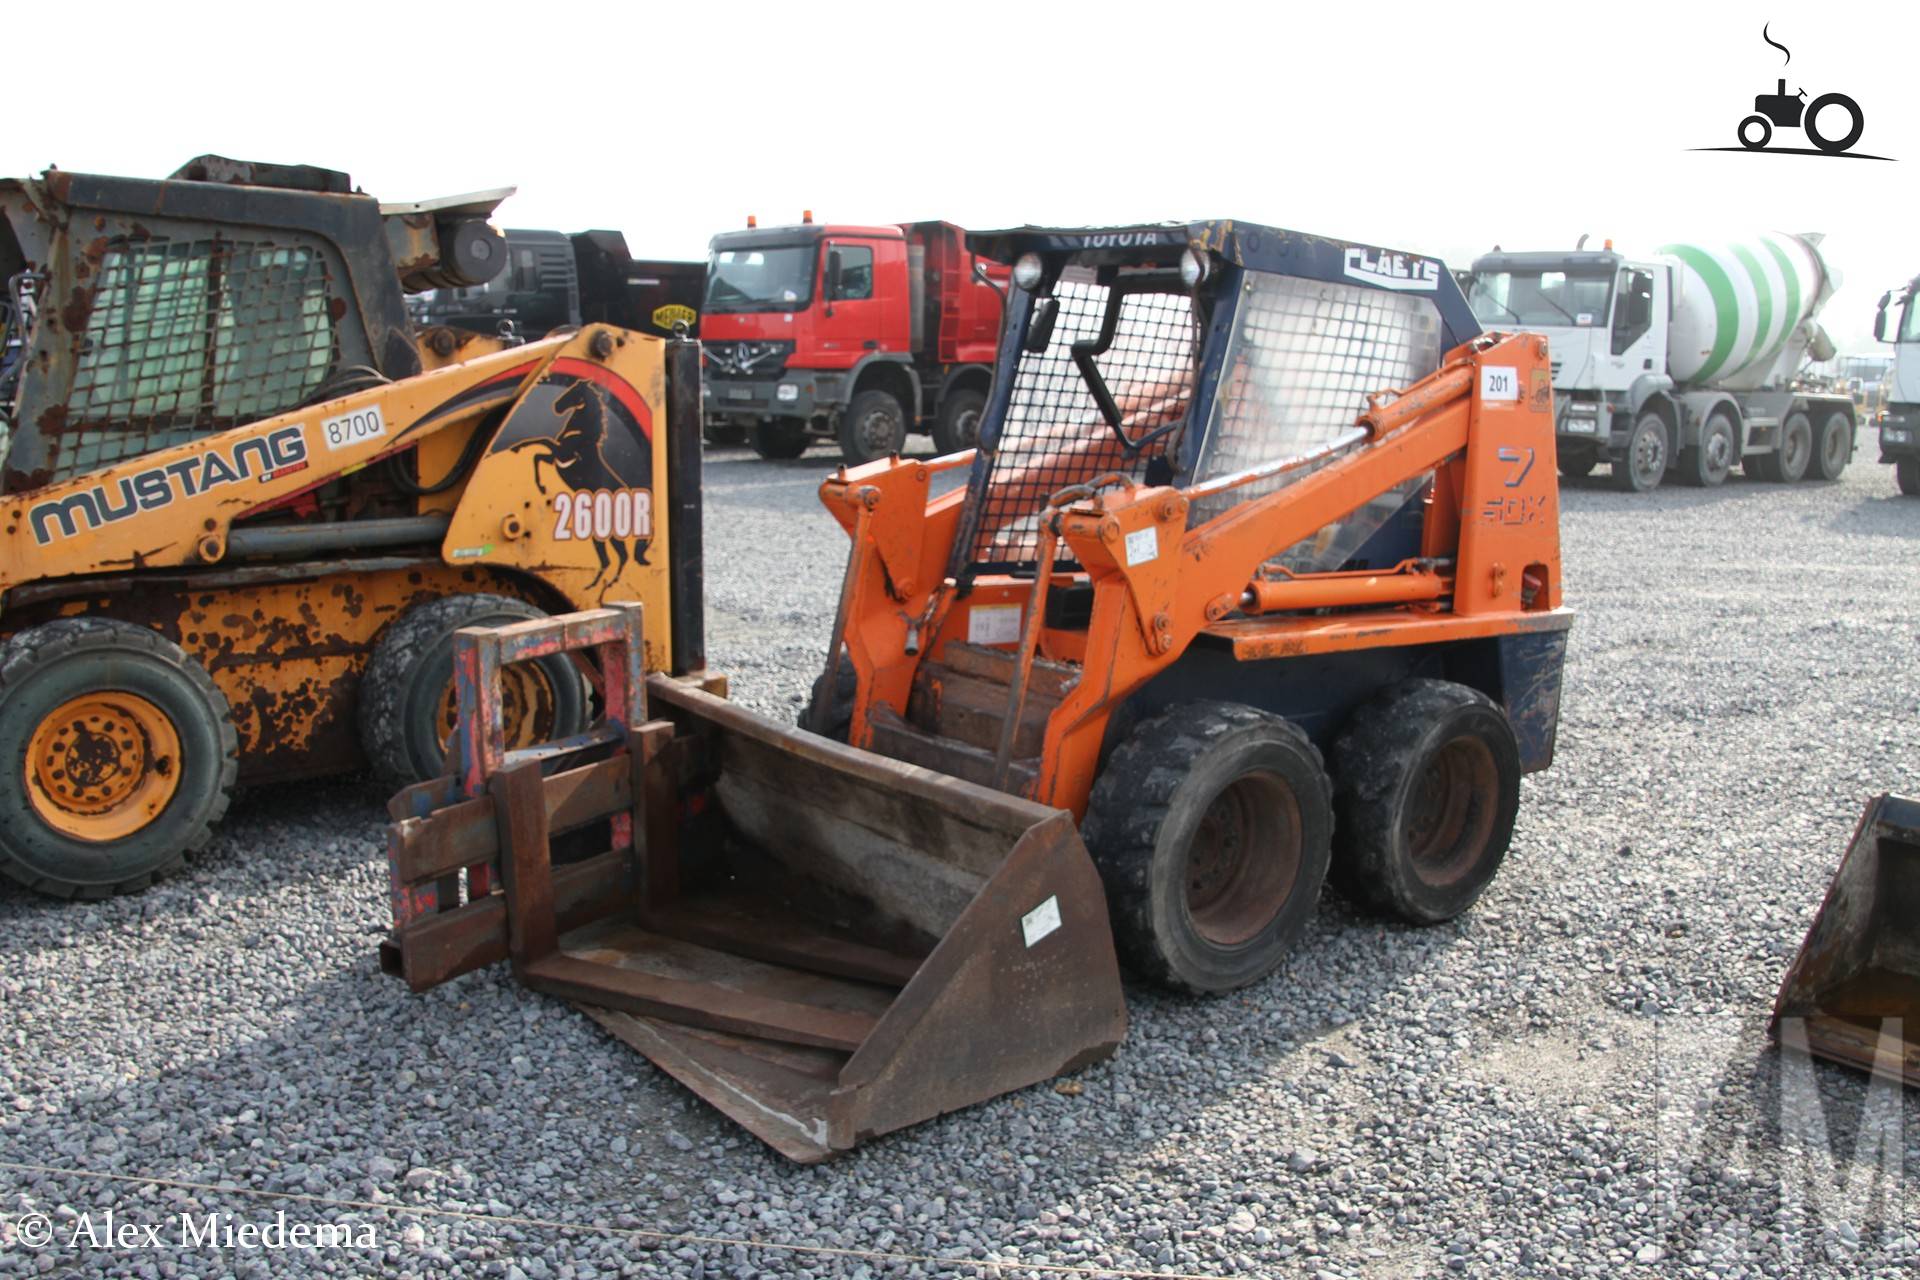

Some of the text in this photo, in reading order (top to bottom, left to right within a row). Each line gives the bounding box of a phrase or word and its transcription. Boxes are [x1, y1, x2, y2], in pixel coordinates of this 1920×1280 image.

[1083, 232, 1158, 249] TOYOTA
[1488, 374, 1509, 393] 201
[327, 411, 380, 444] 8700
[29, 424, 306, 545] MUSTANG
[1497, 447, 1536, 488] 7
[552, 490, 653, 541] 2600R
